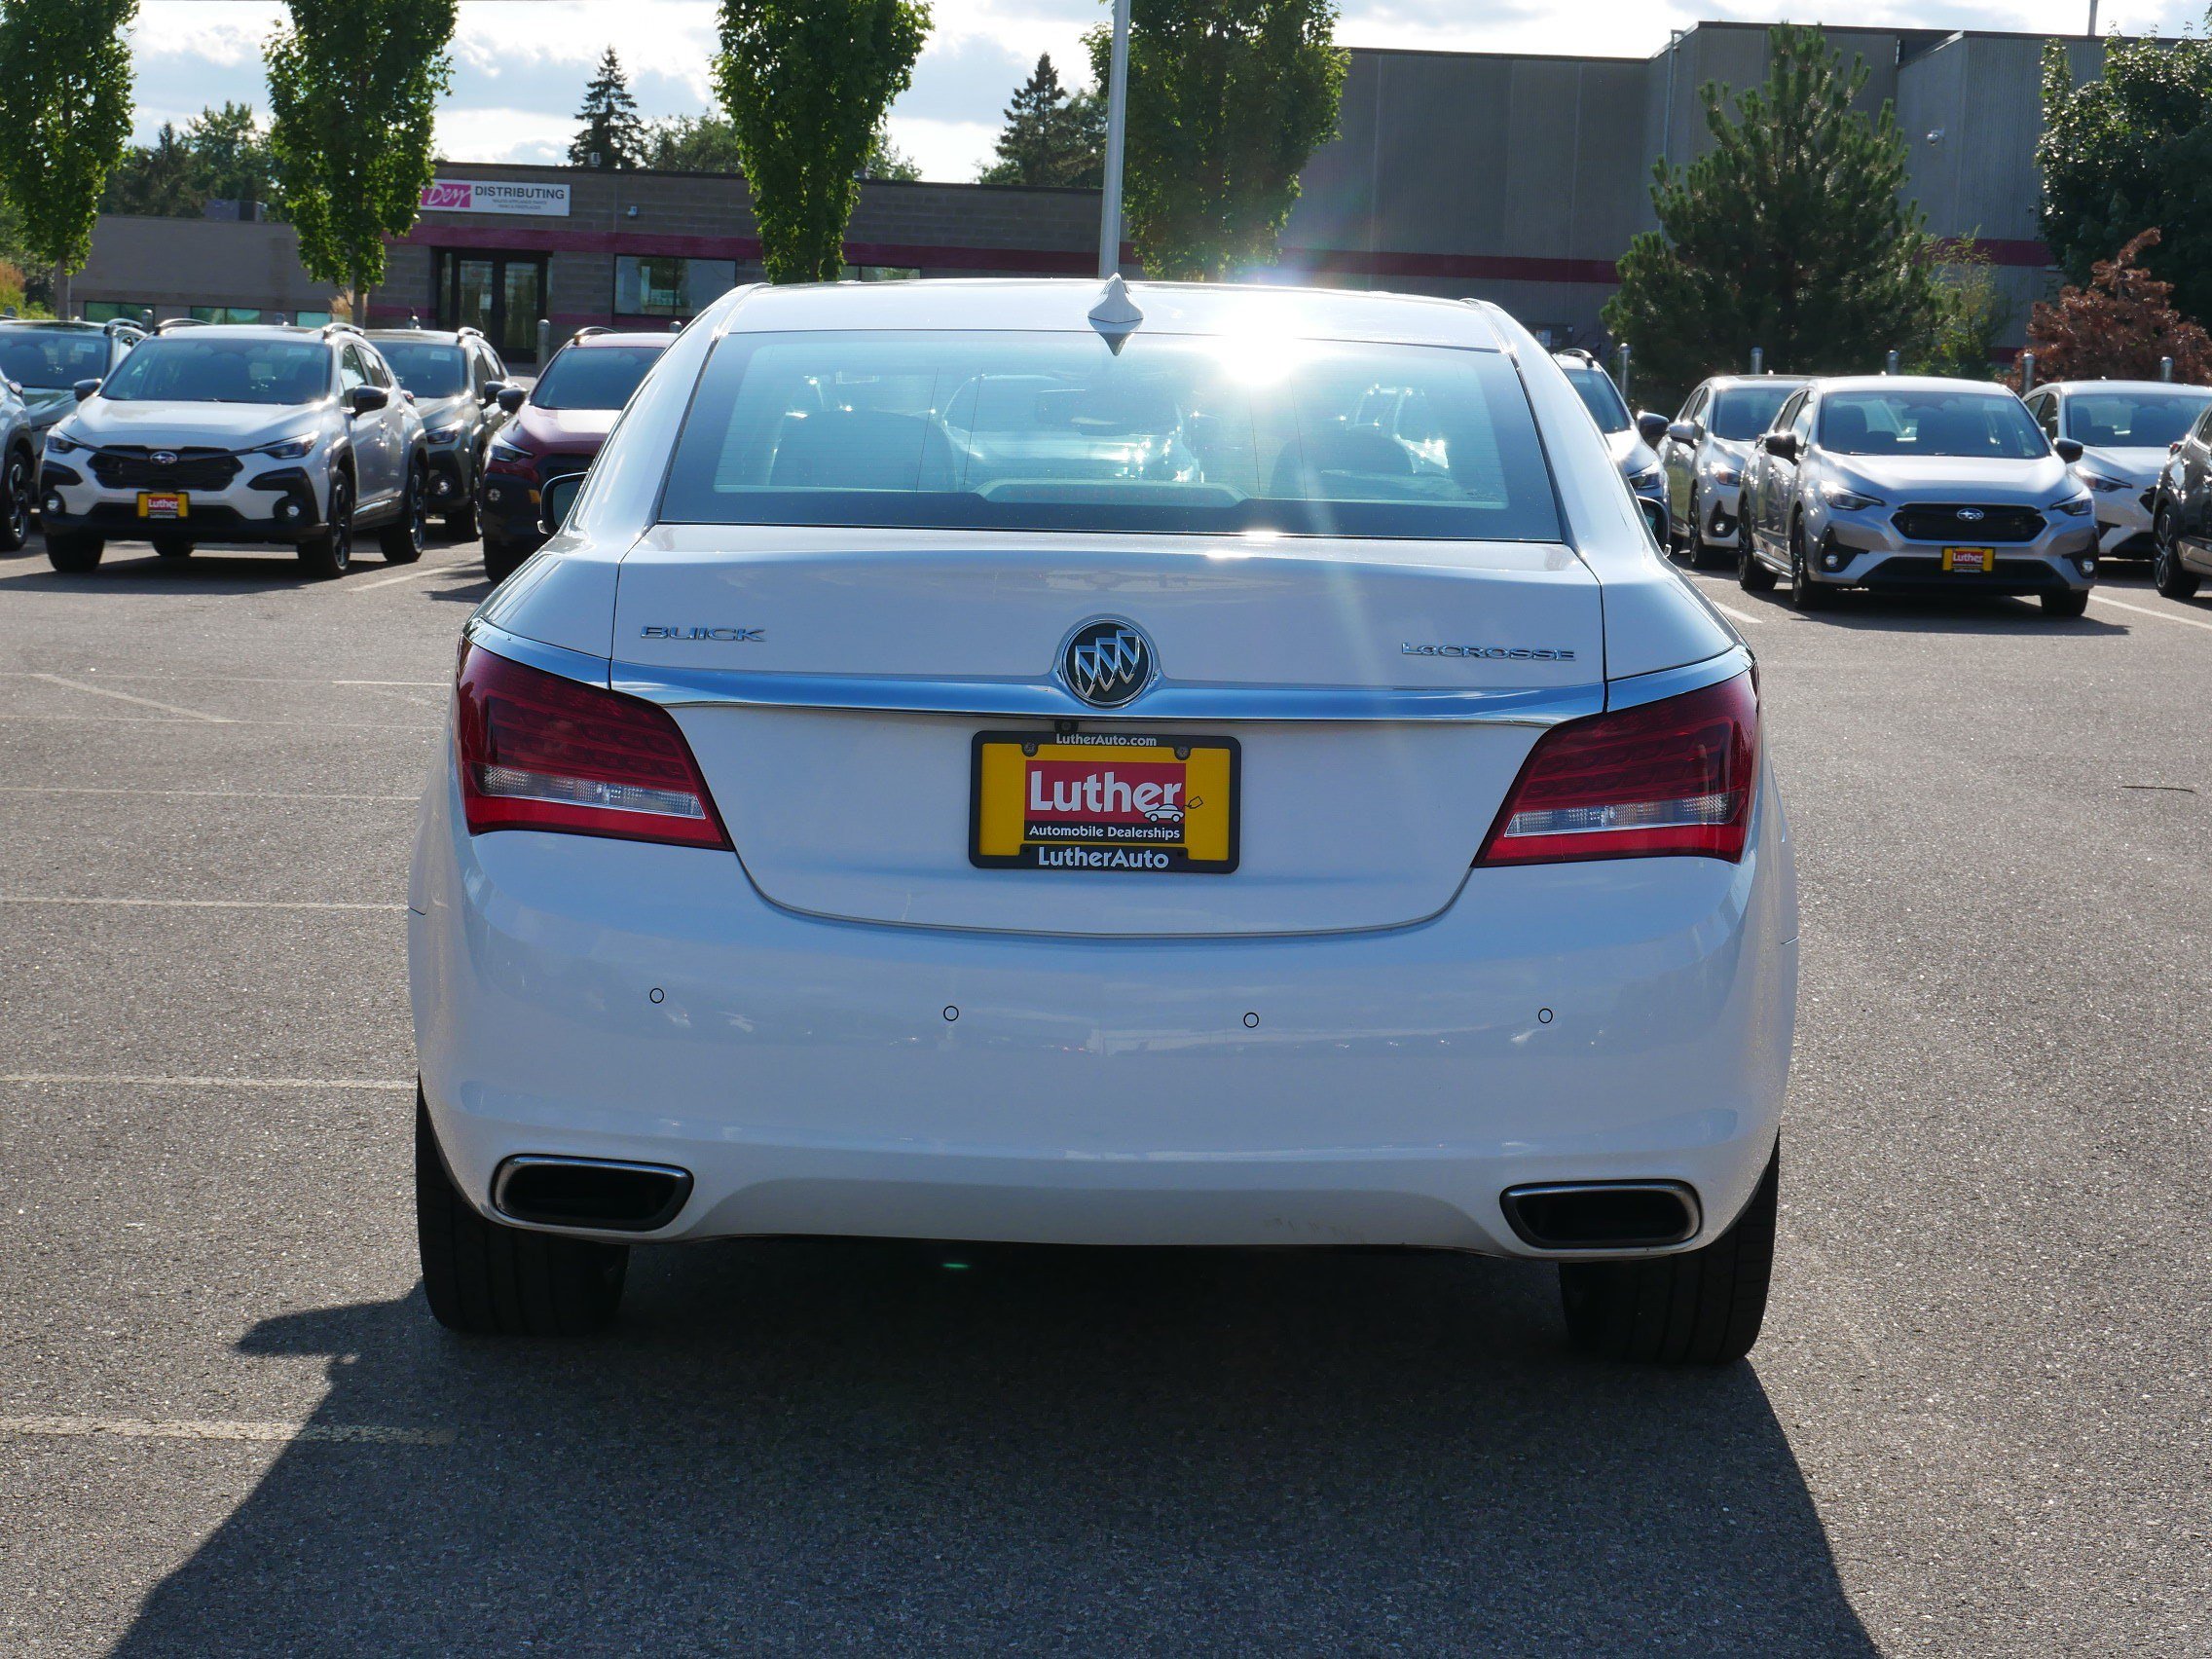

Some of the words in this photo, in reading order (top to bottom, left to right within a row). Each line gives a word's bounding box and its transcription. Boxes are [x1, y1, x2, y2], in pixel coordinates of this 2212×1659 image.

[475, 186, 565, 199] DISTRIBUTING
[148, 498, 178, 509] Luther
[1953, 552, 1983, 563] Luther
[641, 626, 767, 643] BUICK
[1055, 733, 1158, 747] LutherAuto.com
[1030, 771, 1182, 812] Luther
[1028, 825, 1104, 838] Automobile
[1107, 826, 1181, 841] Dealerships
[1038, 846, 1169, 869] LutherAuto
